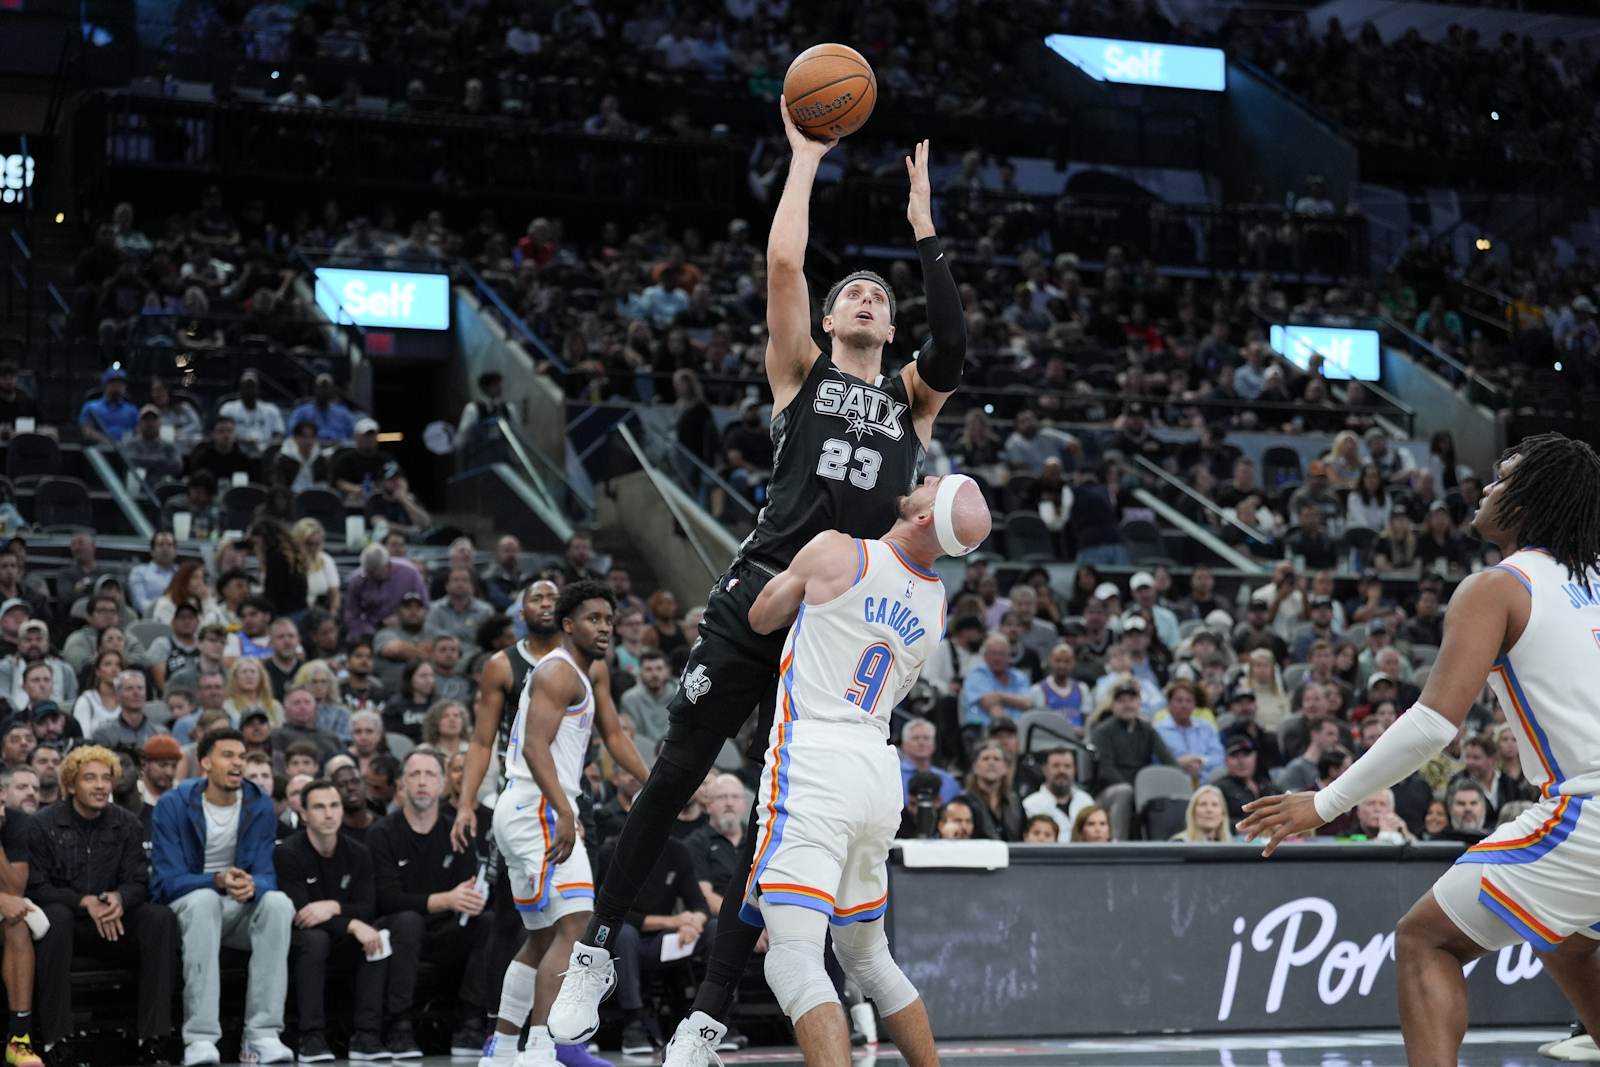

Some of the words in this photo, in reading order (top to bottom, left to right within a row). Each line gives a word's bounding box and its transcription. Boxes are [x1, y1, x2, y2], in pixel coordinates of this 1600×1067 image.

[1104, 45, 1163, 79] Self
[793, 92, 854, 122] Wilson
[344, 279, 416, 318] Self
[813, 379, 908, 442] SATX
[816, 437, 883, 490] 23
[1561, 582, 1600, 609] JON
[864, 596, 926, 646] CARUSO
[844, 642, 894, 714] 9
